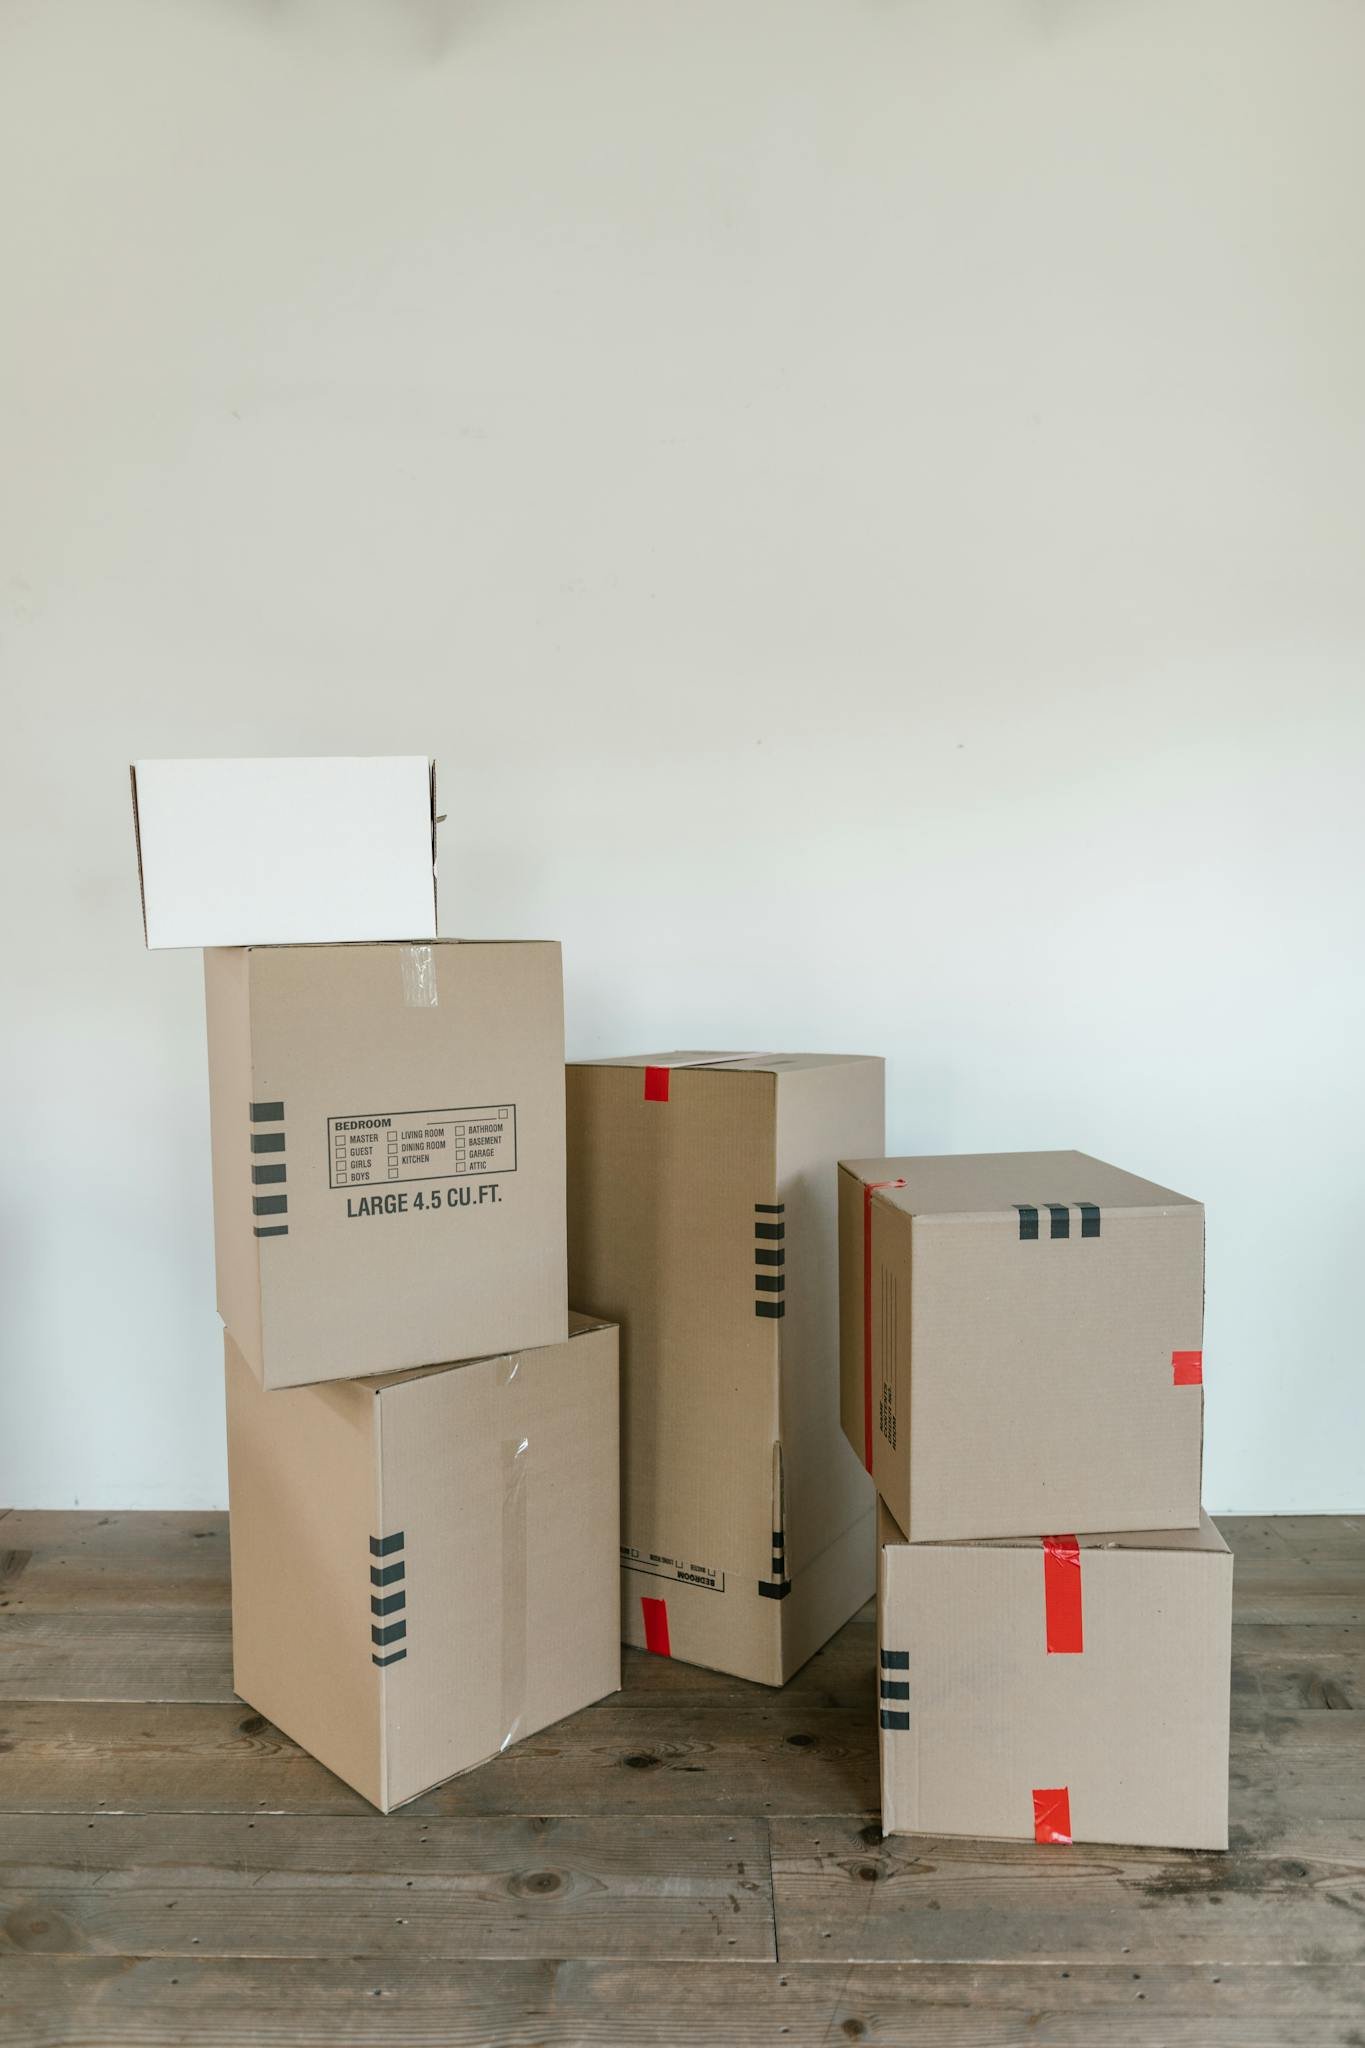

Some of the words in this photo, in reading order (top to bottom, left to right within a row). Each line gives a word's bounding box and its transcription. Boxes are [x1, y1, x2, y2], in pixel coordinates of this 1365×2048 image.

[335, 1118, 392, 1131] BEDROOM
[468, 1124, 503, 1134] BATHROOM
[350, 1134, 378, 1143] MASTER
[401, 1130, 423, 1139] LIVING
[424, 1129, 444, 1137] ROOM
[469, 1136, 502, 1146] BASEMENT
[350, 1147, 373, 1156] GUEST
[402, 1143, 424, 1152] DINING
[426, 1141, 445, 1150] ROOM
[469, 1149, 495, 1158] GARAGE
[351, 1159, 372, 1169] GIRLS
[402, 1155, 429, 1164] KITCHEN
[470, 1162, 487, 1170] ATTIC
[351, 1173, 369, 1181] BOYS
[347, 1193, 408, 1217] LARGE
[413, 1191, 441, 1210] 4.5
[447, 1184, 502, 1207] CU.FT.
[677, 1571, 715, 1586] BEDROOM
